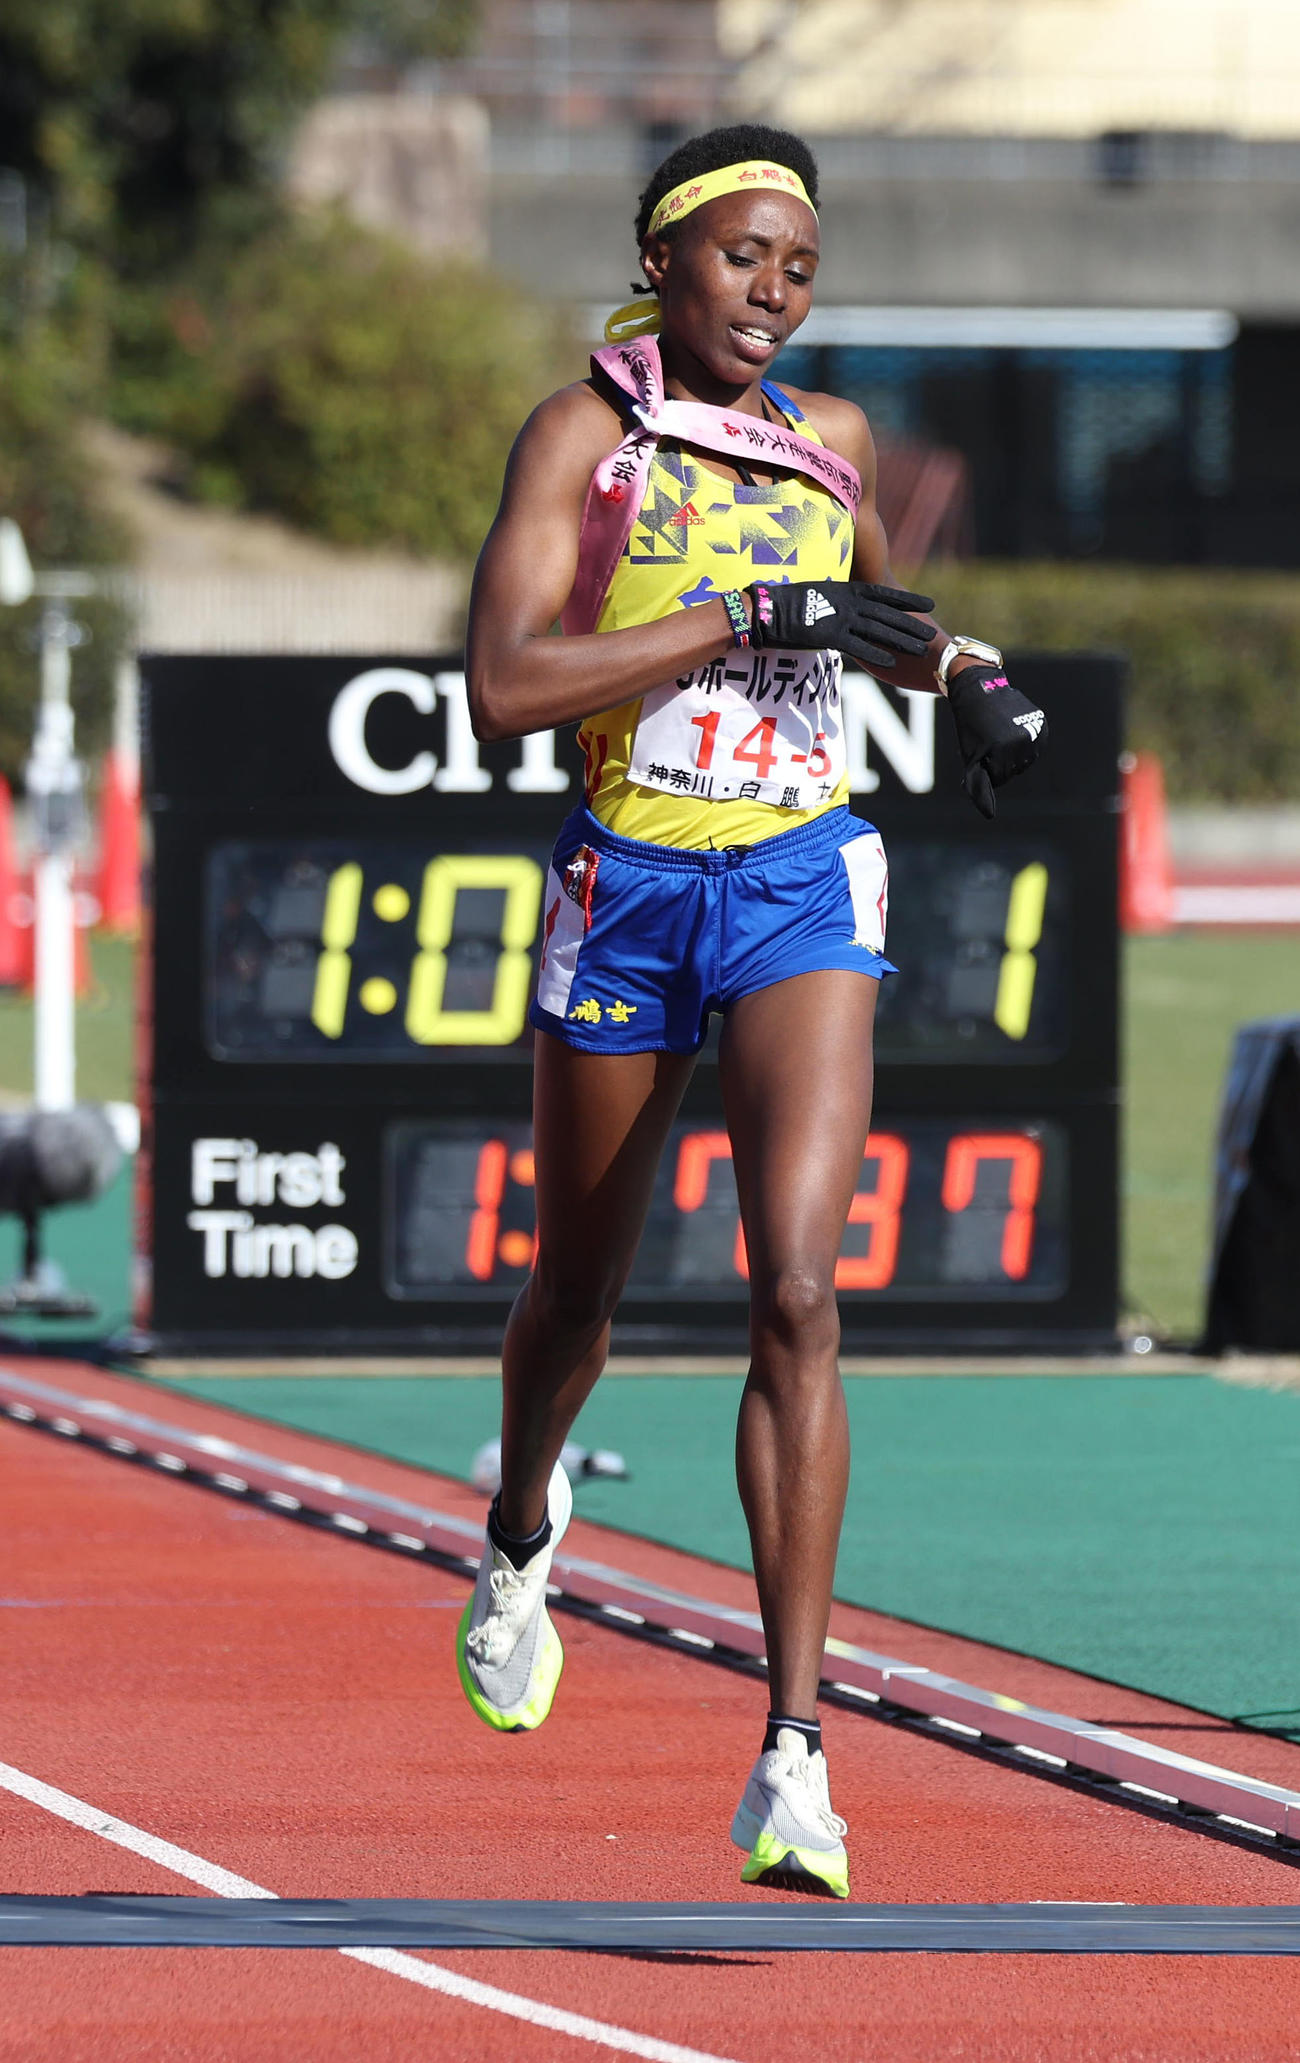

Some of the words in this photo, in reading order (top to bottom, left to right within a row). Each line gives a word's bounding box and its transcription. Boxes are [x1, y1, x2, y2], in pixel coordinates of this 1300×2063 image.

[668, 516, 706, 527] adidas
[805, 588, 817, 627] adidas
[691, 710, 832, 779] 14-5
[192, 1137, 346, 1207] First
[187, 1210, 359, 1280] Time
